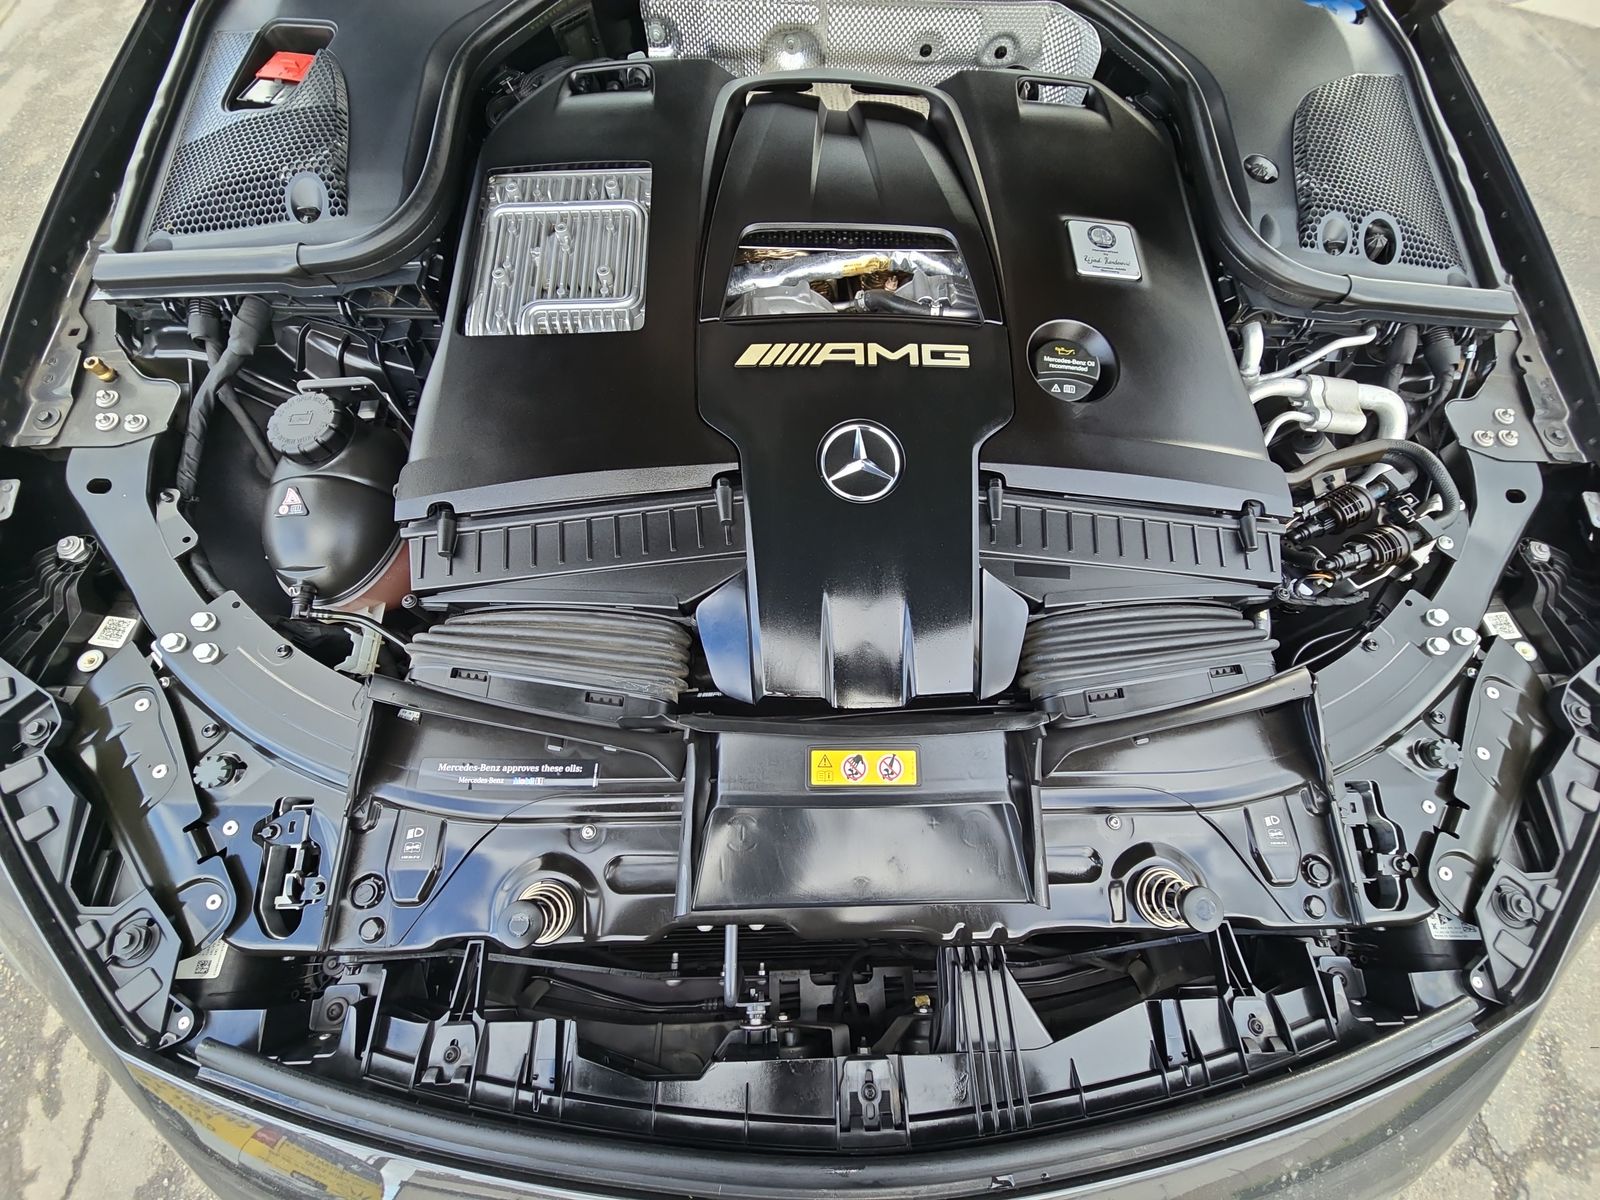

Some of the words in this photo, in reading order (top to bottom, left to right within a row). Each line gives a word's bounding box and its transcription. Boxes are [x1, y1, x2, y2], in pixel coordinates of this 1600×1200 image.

[810, 343, 970, 368] AMG
[1043, 356, 1086, 366] Mercedes-Benz
[1049, 363, 1088, 372] recommended
[437, 763, 501, 772] Mercedes-Benz
[502, 765, 540, 775] approves
[541, 764, 564, 773] these
[458, 776, 504, 784] Mercedes-Benz
